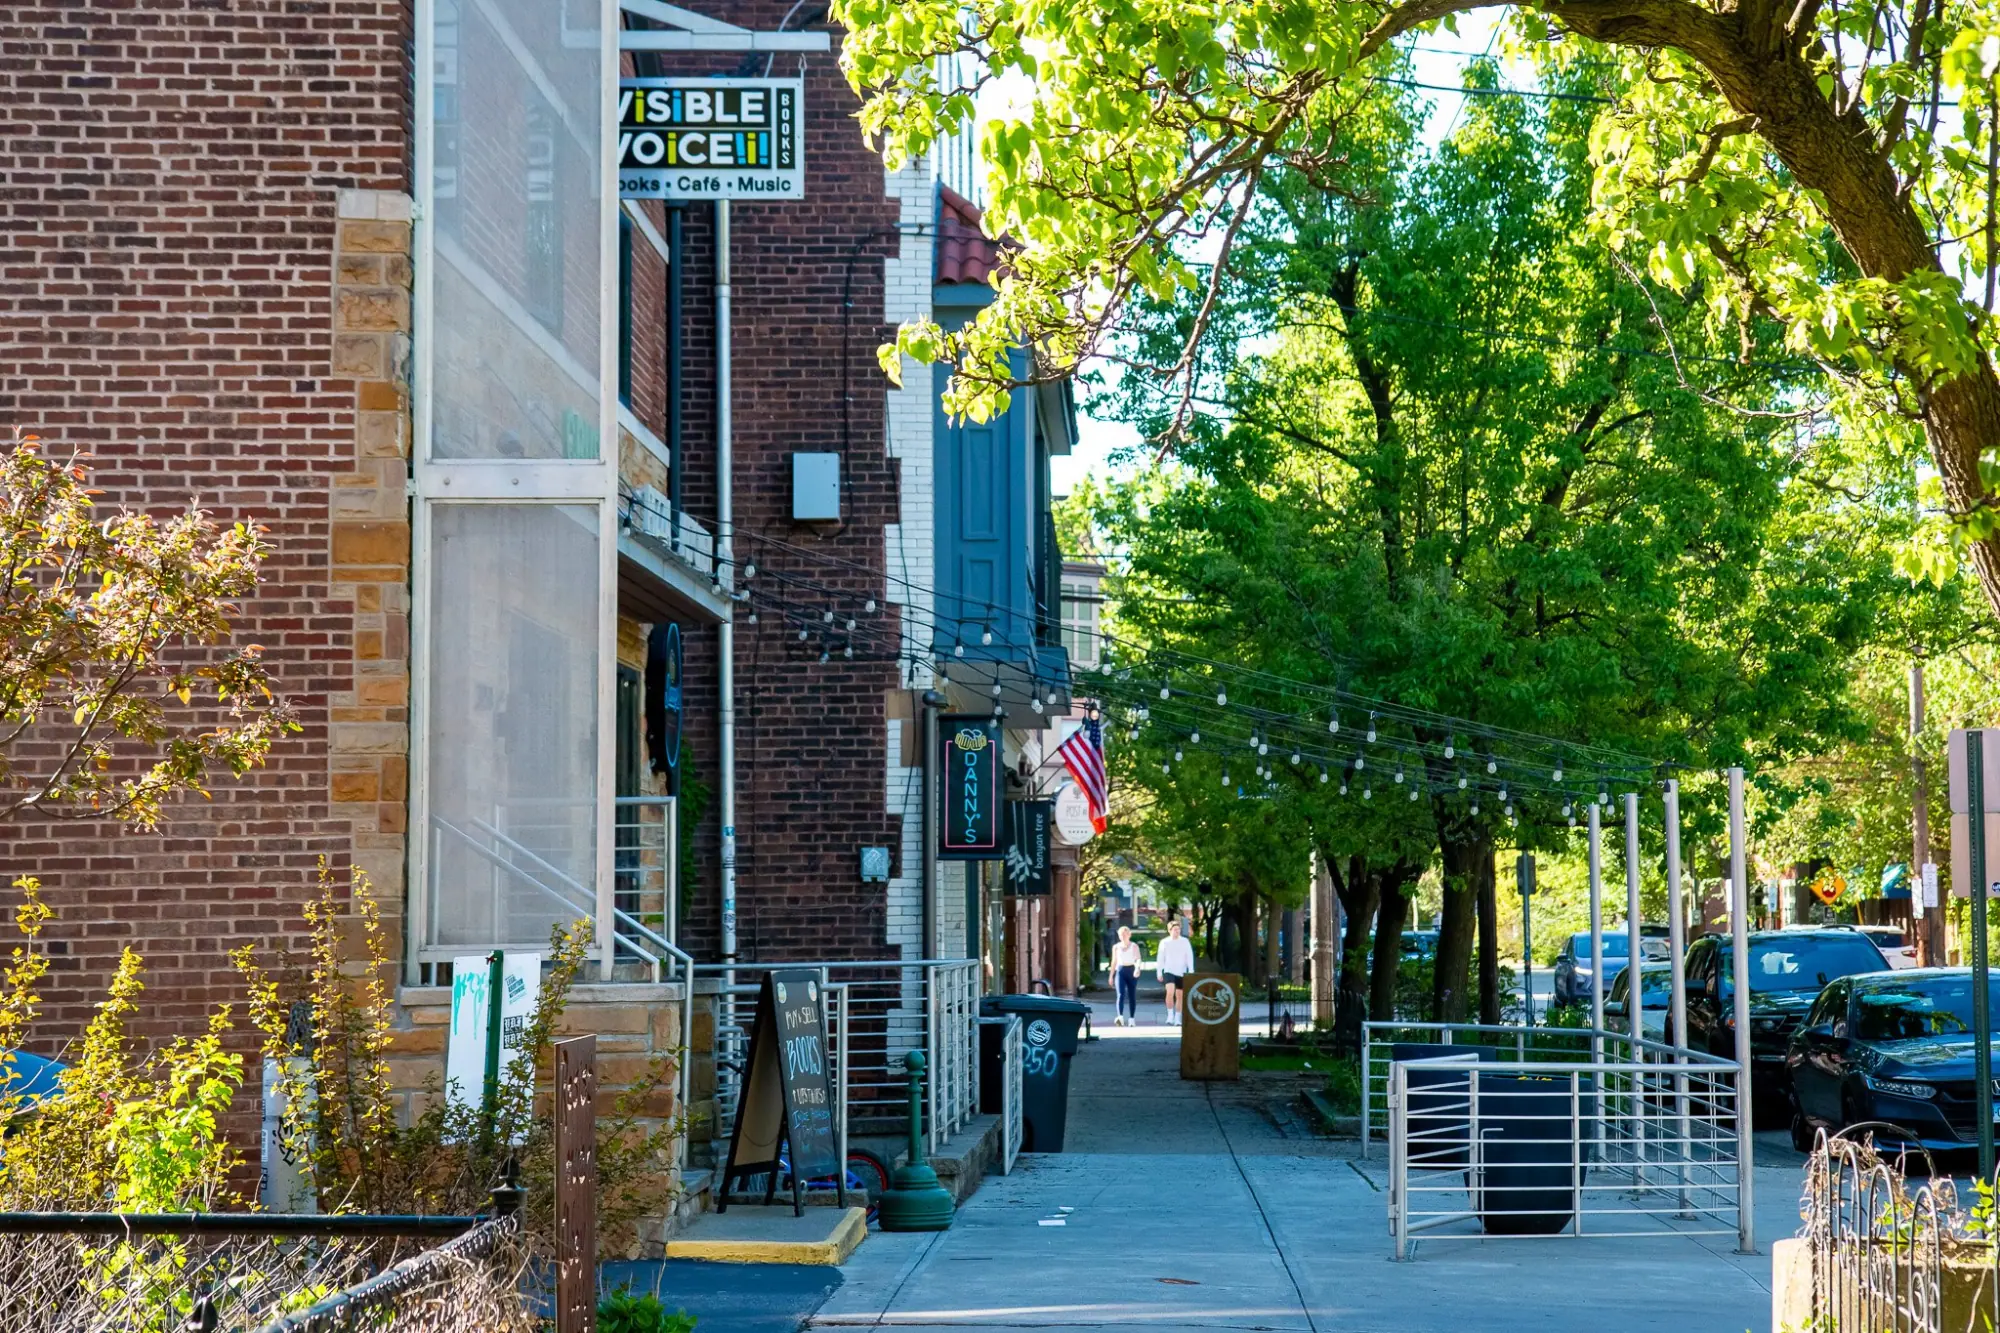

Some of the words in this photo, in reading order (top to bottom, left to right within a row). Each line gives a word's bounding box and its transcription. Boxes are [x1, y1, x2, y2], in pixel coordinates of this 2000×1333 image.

[781, 93, 790, 164] BOOKS
[619, 176, 660, 191] ooks
[677, 176, 721, 191] Café
[738, 176, 791, 192] Music
[964, 752, 981, 843] DANNY'S
[1035, 813, 1043, 831] tree
[1034, 833, 1046, 869] banyan
[802, 1006, 818, 1024] SELL
[786, 1036, 821, 1080] BOOKS
